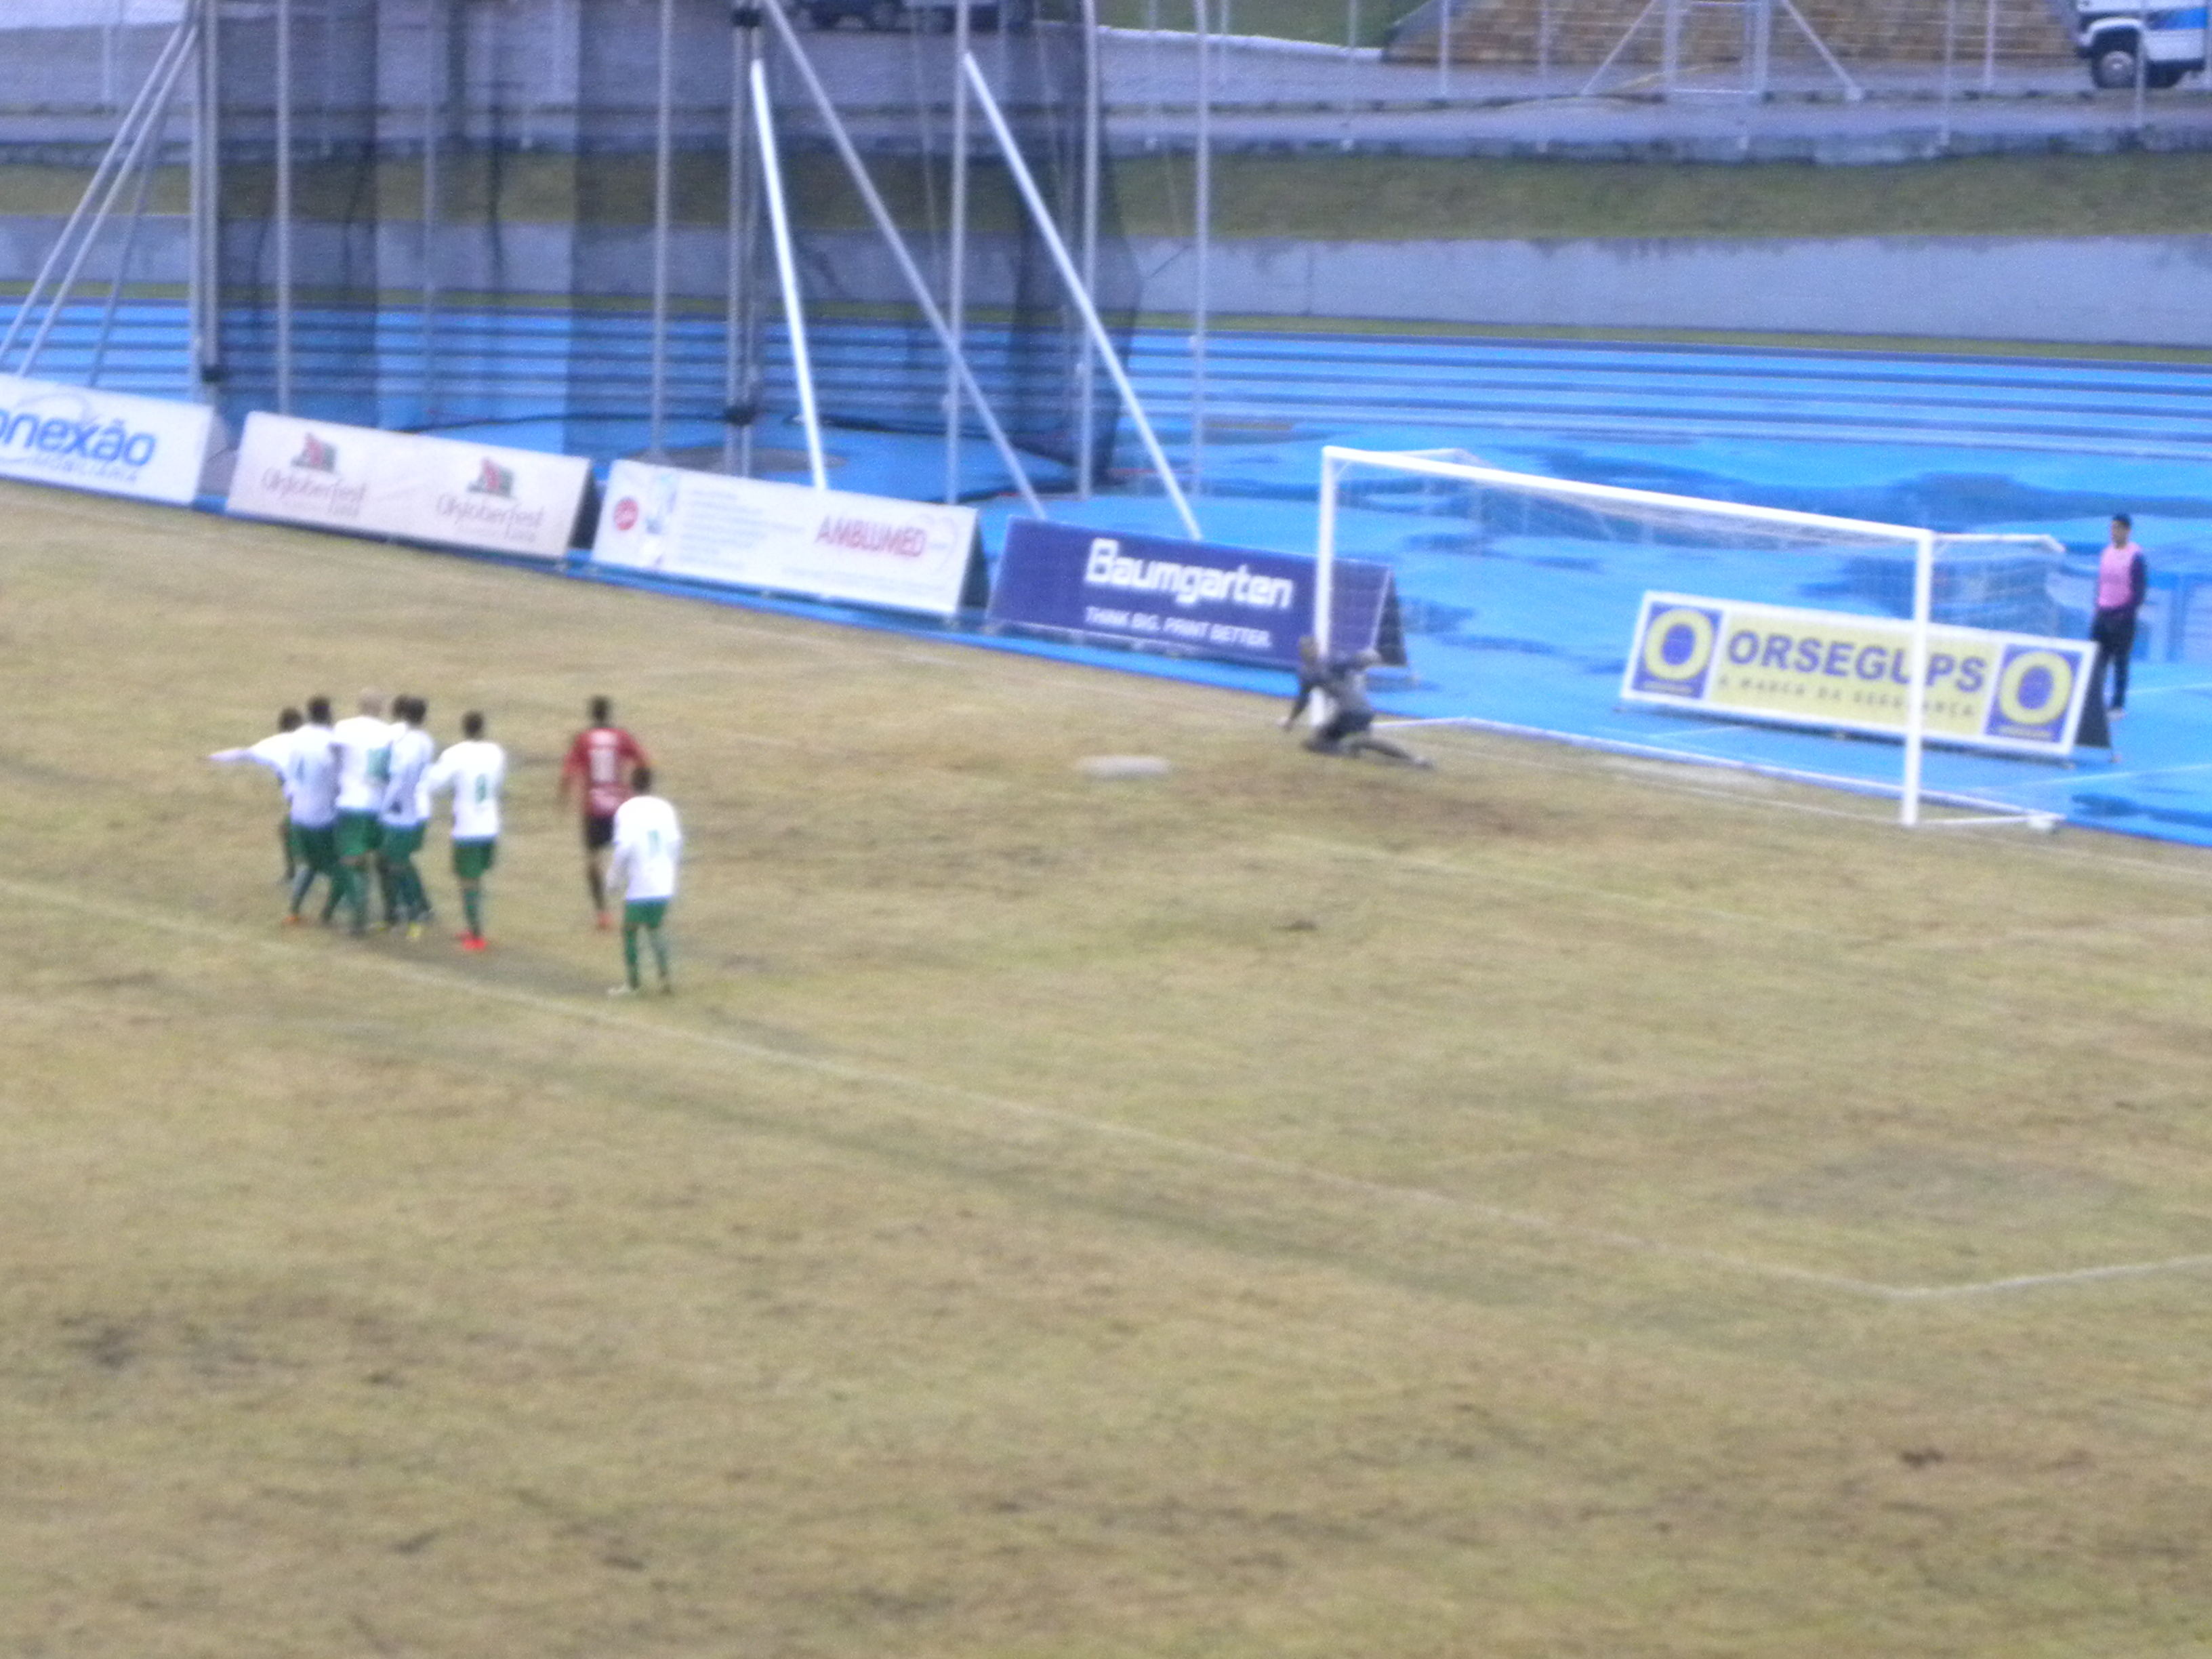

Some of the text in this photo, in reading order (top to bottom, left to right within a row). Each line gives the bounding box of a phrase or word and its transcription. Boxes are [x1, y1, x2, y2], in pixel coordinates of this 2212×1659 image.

[1085, 538, 1293, 608] Baumgarten
[1085, 606, 1129, 627] THINK
[1162, 617, 1210, 638] PRINT
[1728, 630, 1987, 693] ORSEGUPS
